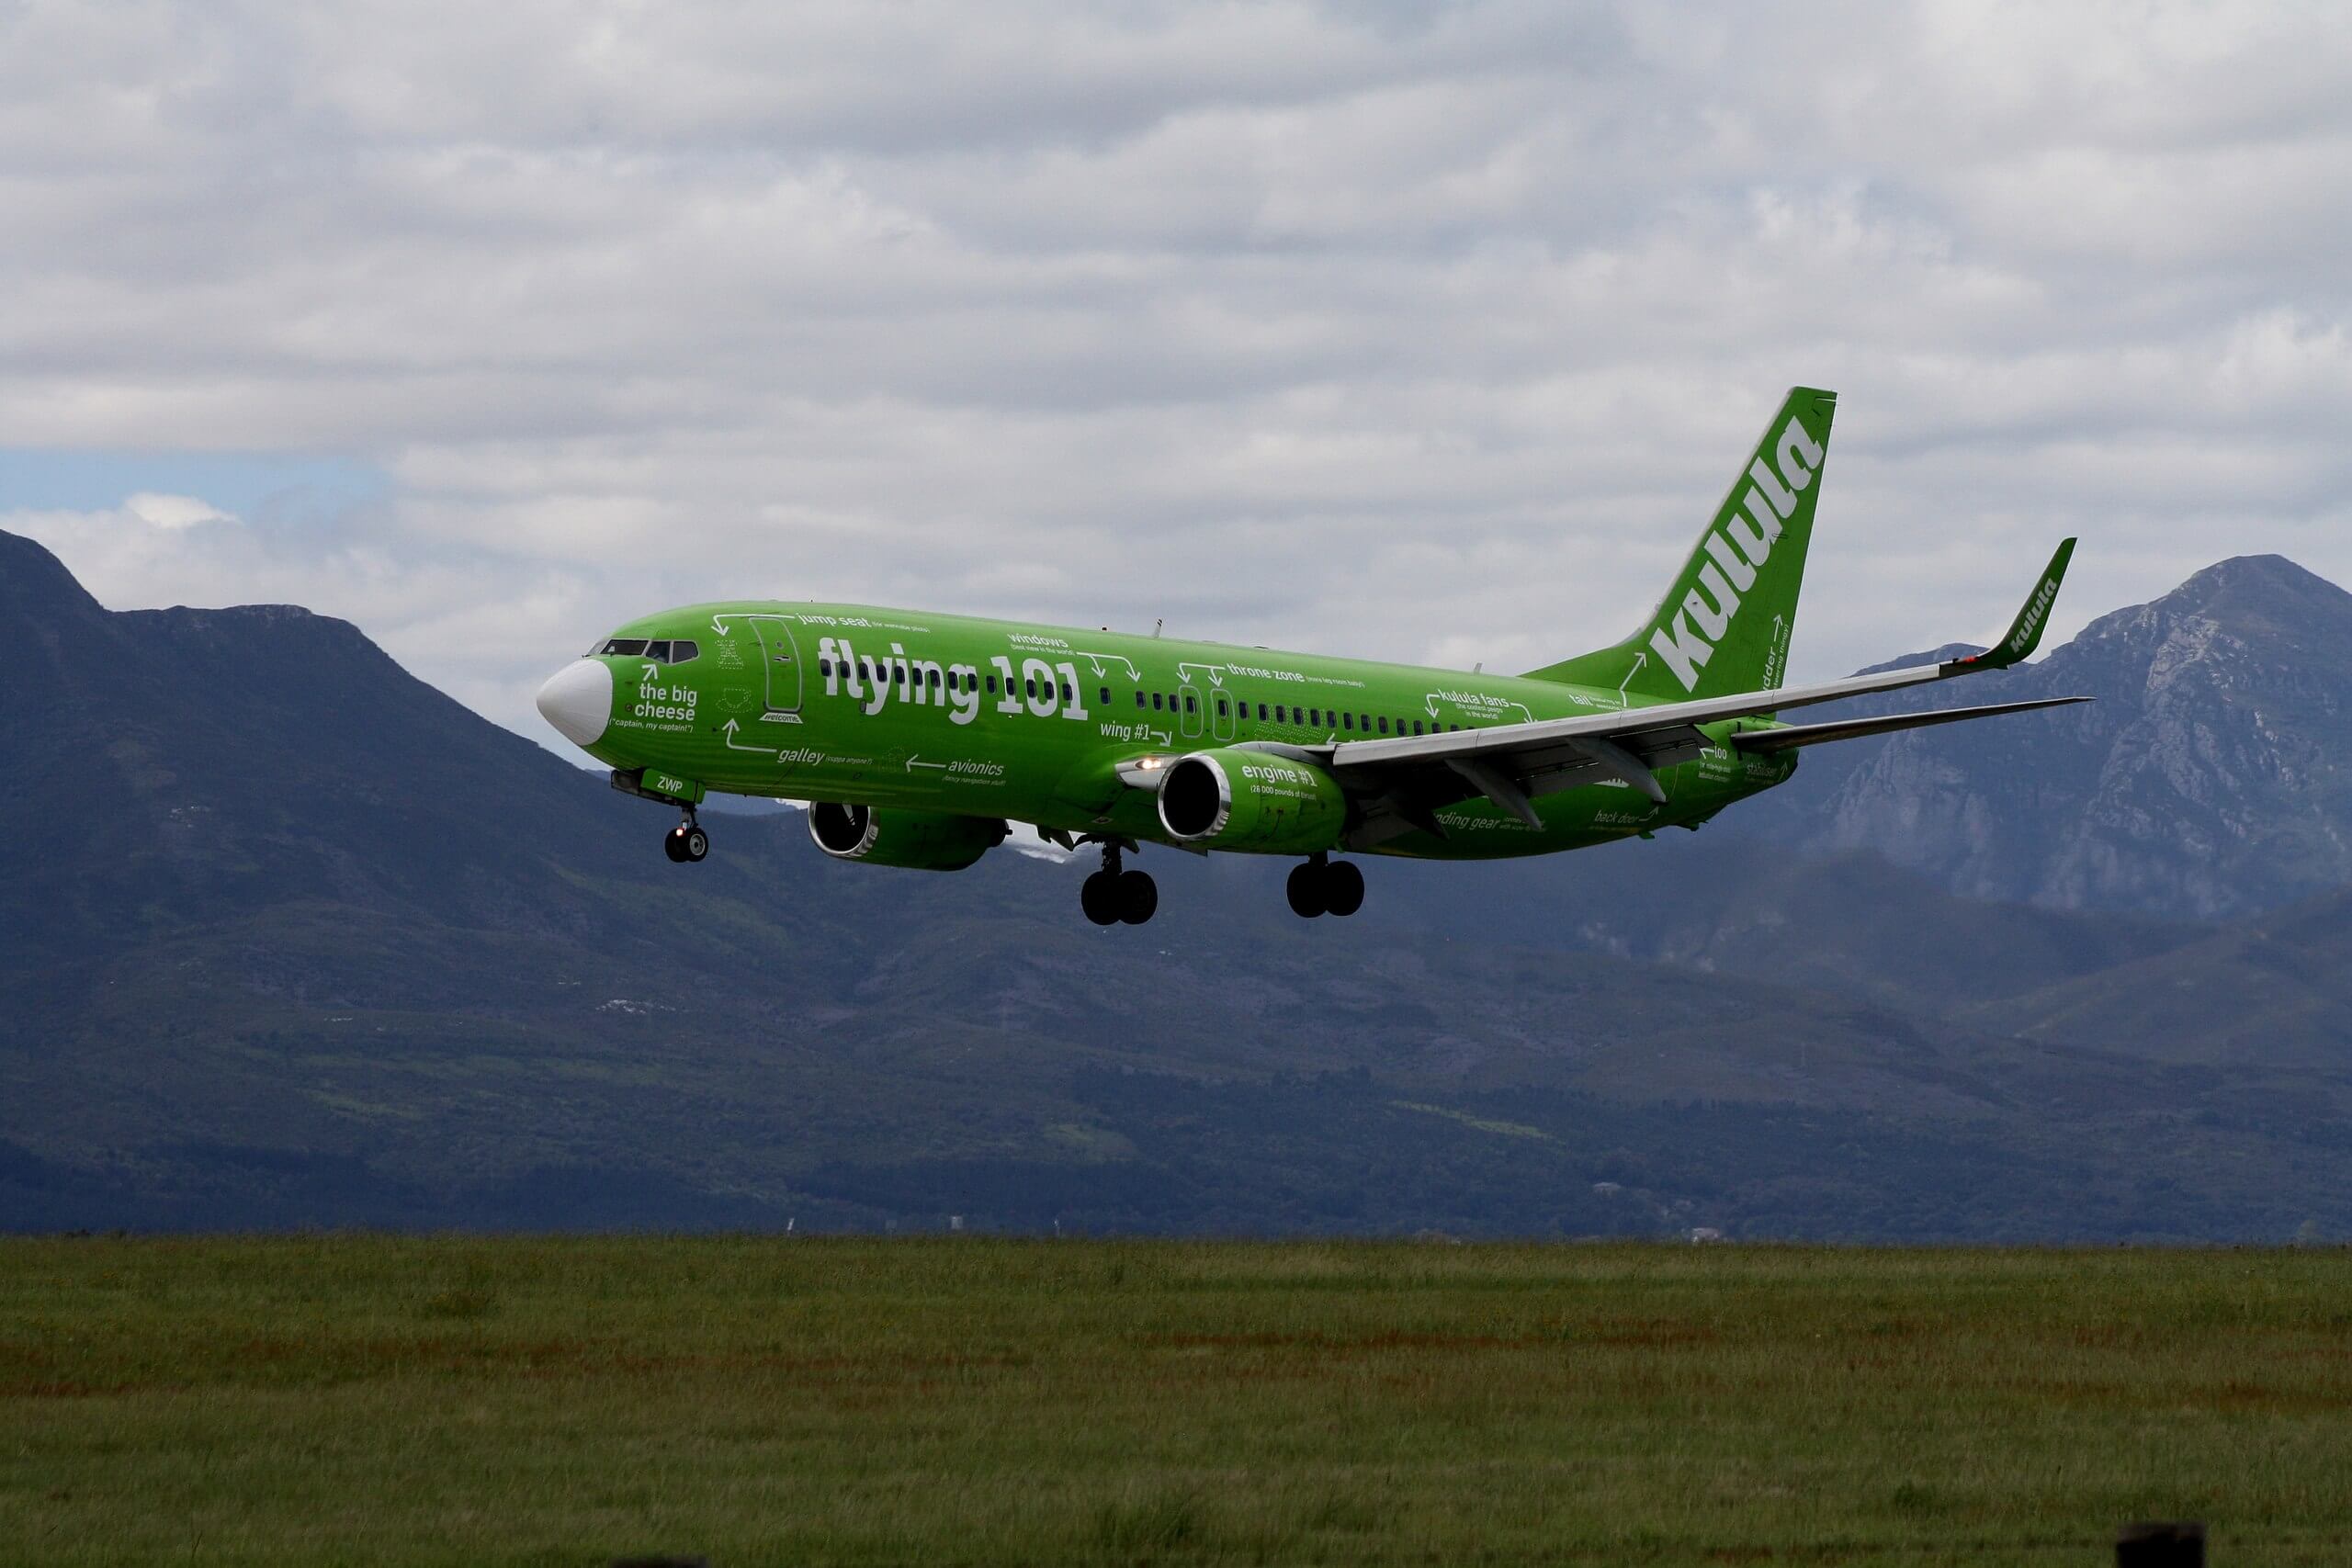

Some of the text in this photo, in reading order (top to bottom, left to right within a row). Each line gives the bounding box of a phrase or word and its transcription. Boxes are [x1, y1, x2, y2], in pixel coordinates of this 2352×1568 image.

[1649, 415, 1824, 693] kulula
[796, 613, 836, 626] jump
[839, 617, 872, 627] seat
[2009, 578, 2057, 654] kulula
[1007, 633, 1069, 648] windows
[818, 637, 1088, 725] flying 101
[1227, 662, 1305, 682] throne zone
[639, 682, 697, 707] the big
[1438, 689, 1510, 707] kulula fans
[1568, 694, 1593, 705] tail
[635, 700, 695, 721] cheese
[764, 714, 799, 723] welcome
[646, 722, 657, 730] my
[1101, 720, 1149, 741] wing #1
[777, 748, 825, 766] galley
[1714, 742, 1727, 760] loo
[948, 759, 1004, 775] avionics
[1242, 764, 1317, 787] engine #1
[657, 776, 683, 793] ZWP
[1470, 818, 1500, 830] gear
[1594, 809, 1617, 823] back
